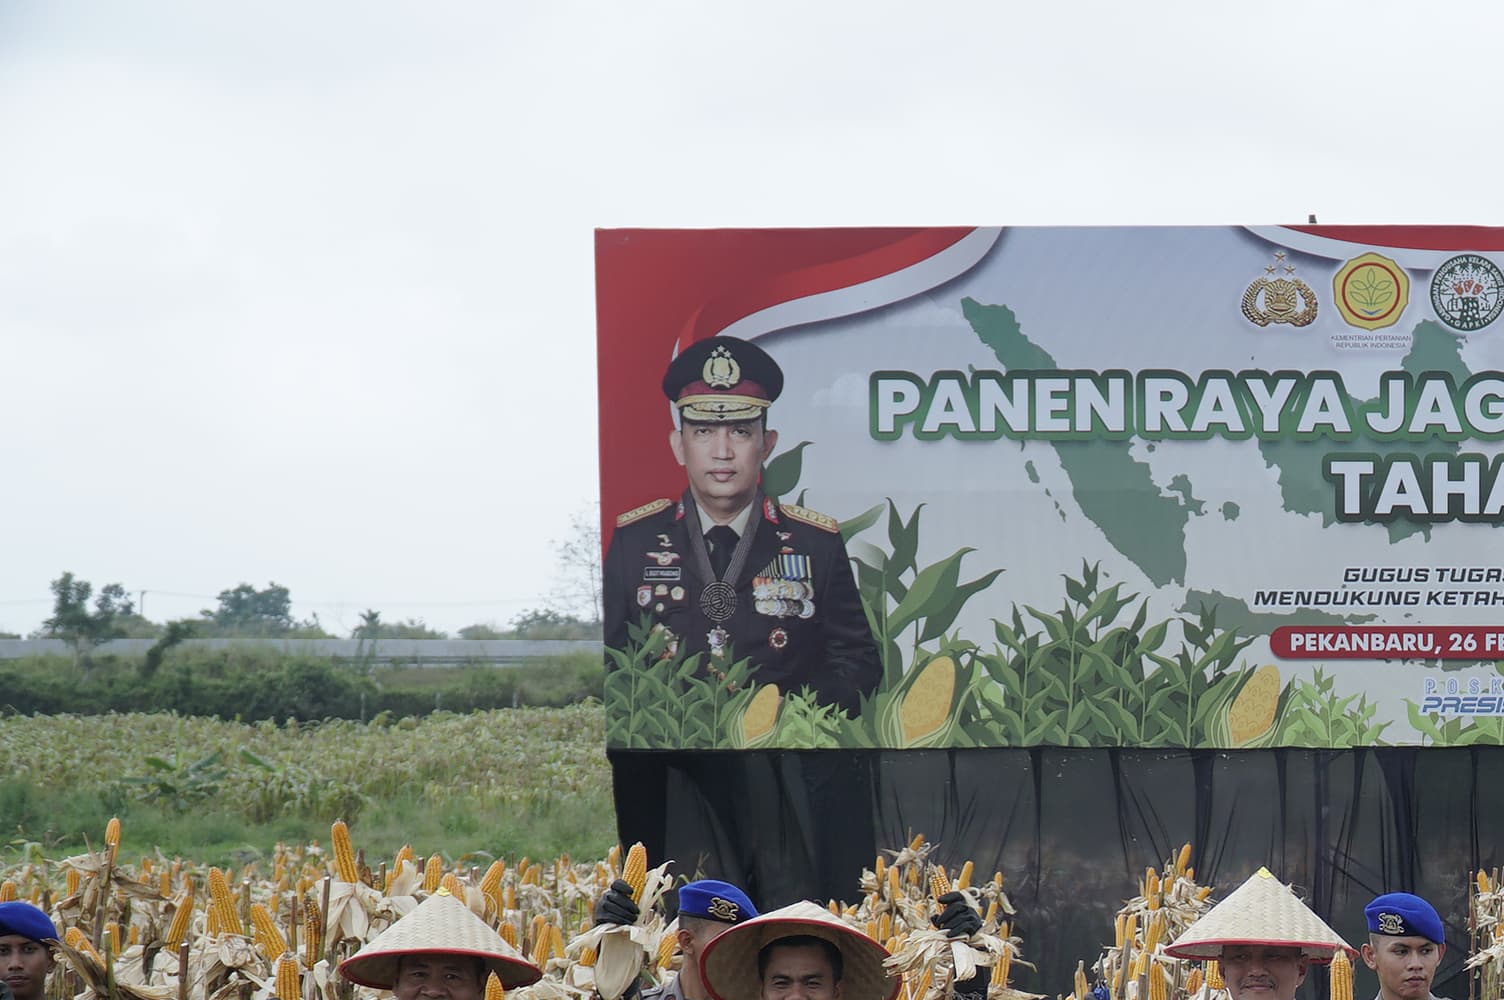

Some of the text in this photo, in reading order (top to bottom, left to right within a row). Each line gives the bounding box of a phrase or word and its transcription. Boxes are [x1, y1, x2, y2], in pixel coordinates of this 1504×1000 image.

[878, 378, 1125, 433] PANEN
[1145, 378, 1352, 433] RAYA
[1343, 568, 1429, 583] GUGUS
[1254, 591, 1420, 606] MENDUKUNG
[1290, 633, 1442, 655] PEKANBARU,
[1449, 633, 1477, 652] 26
